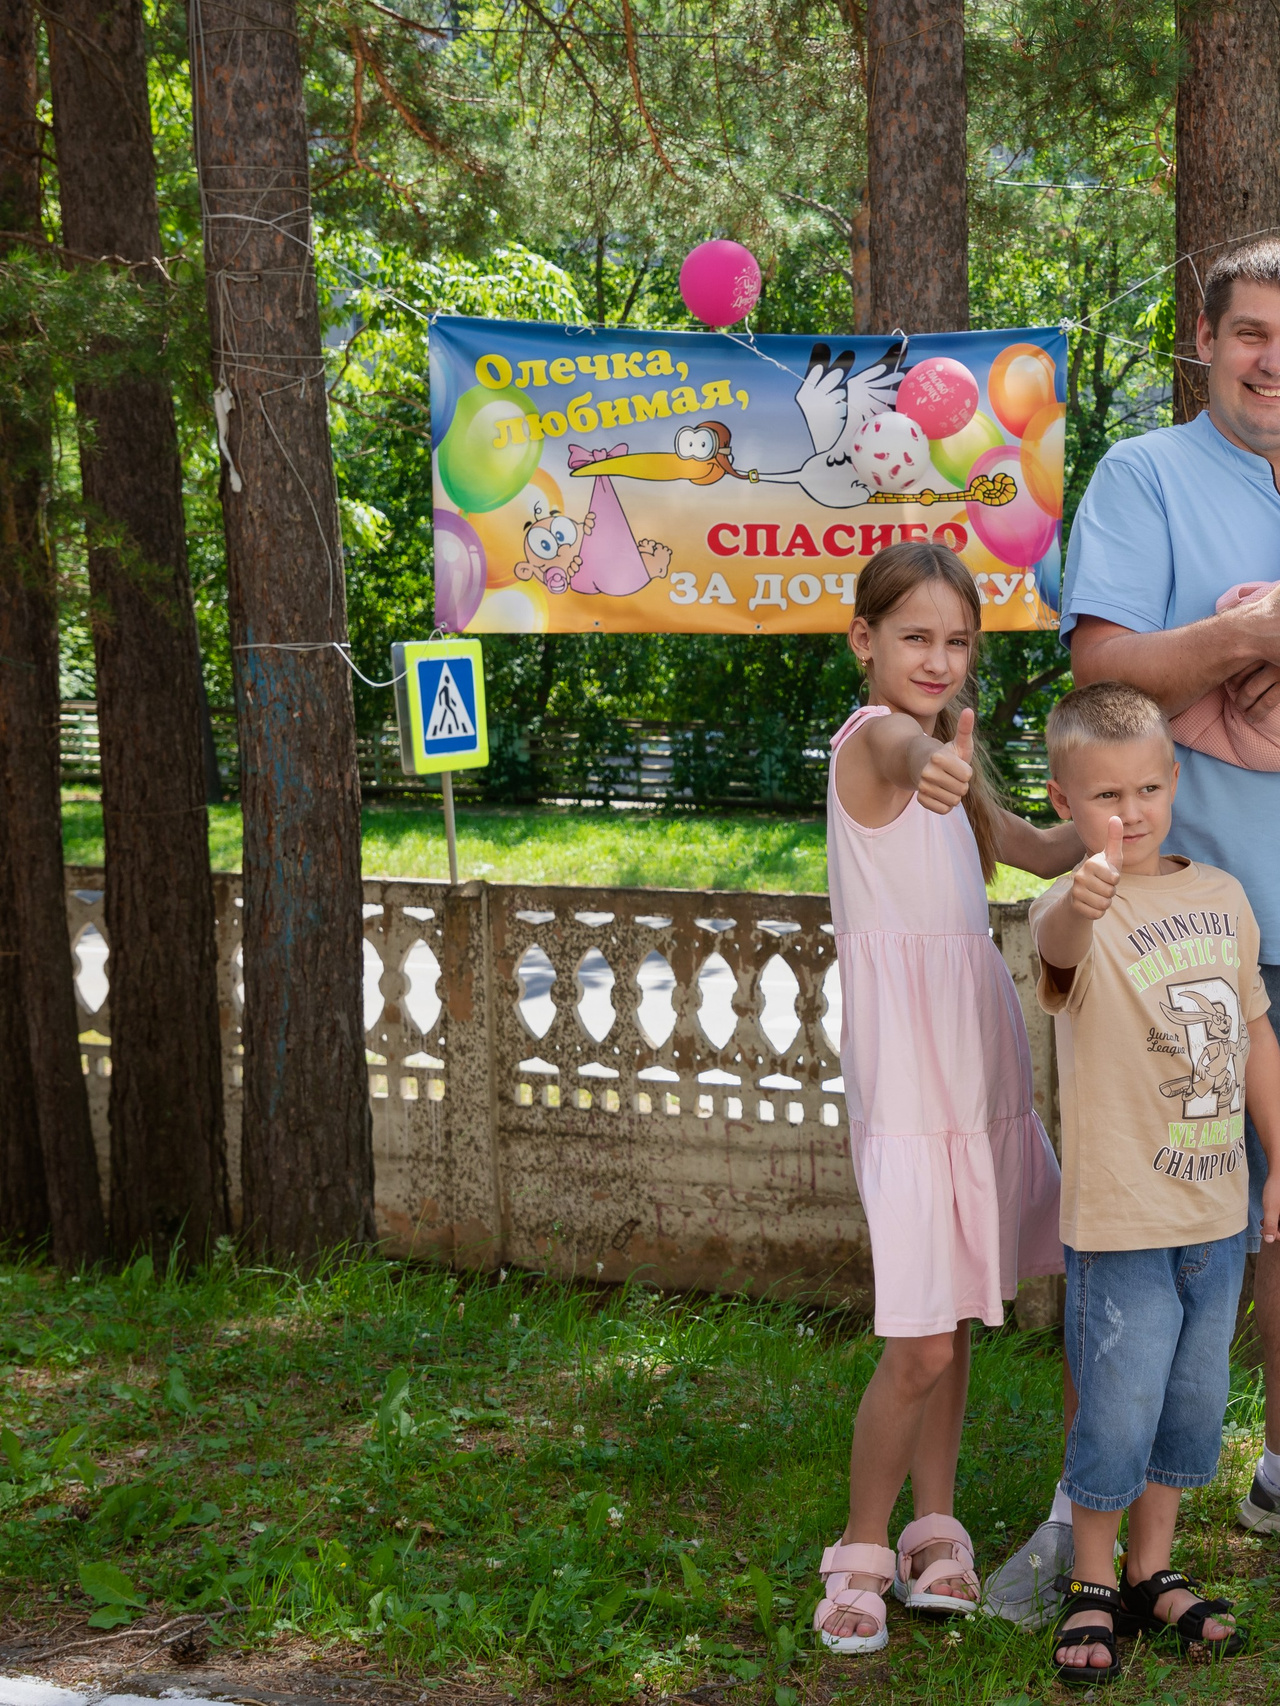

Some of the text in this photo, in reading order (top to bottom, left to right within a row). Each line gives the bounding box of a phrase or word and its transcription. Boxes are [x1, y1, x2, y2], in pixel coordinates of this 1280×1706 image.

[475, 349, 689, 390] Олечка,
[493, 380, 750, 448] любимая,
[669, 571, 737, 605] ЗА
[1126, 911, 1239, 957] INVINCIBL
[1146, 1040, 1186, 1057] League
[1168, 1122, 1198, 1148] WE
[1197, 1119, 1228, 1148] ARE
[1083, 1586, 1111, 1597] BIKER
[1160, 1573, 1183, 1584] BIKER
